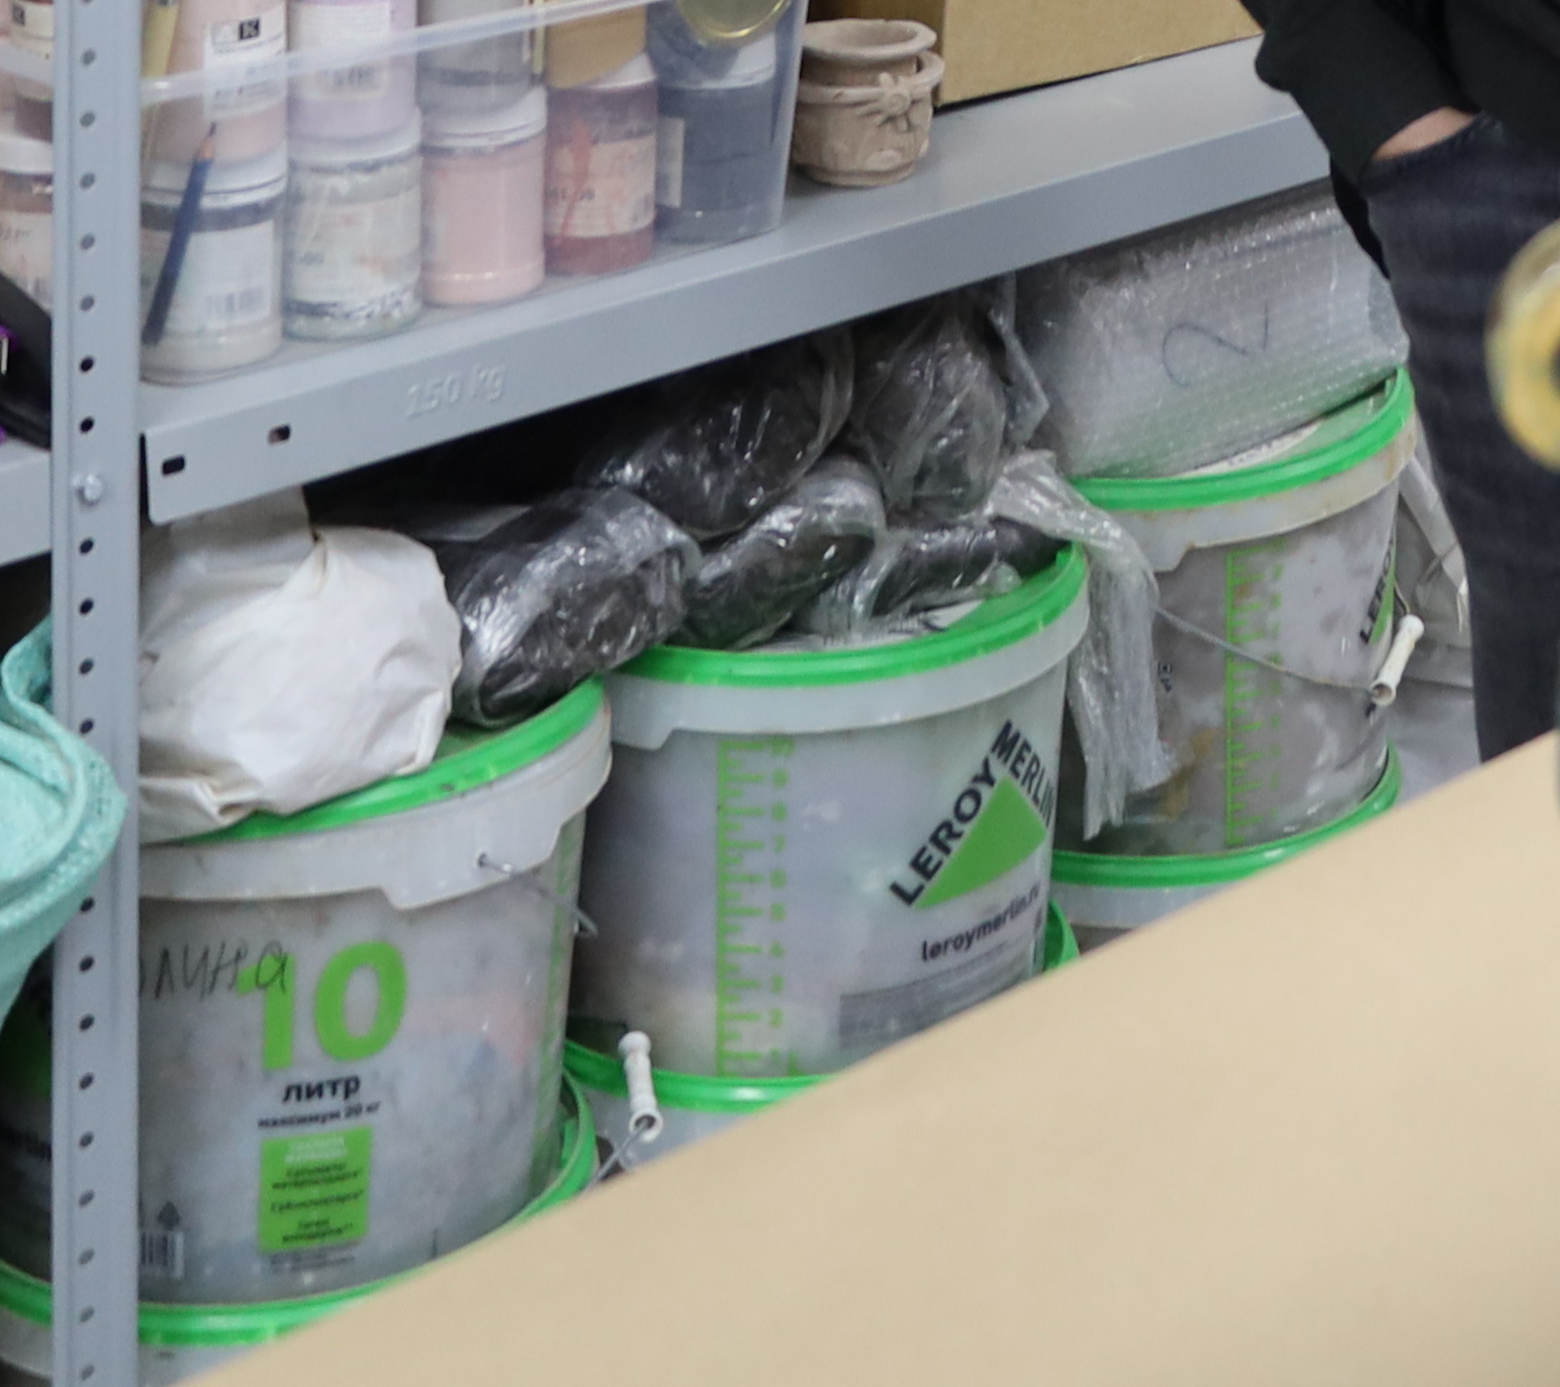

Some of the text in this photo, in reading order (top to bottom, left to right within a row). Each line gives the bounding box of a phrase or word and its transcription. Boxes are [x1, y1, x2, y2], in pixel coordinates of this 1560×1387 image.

[890, 719, 1055, 907] LEROY MERLIN
[237, 940, 408, 1069] 10
[282, 1075, 361, 1103] литр
